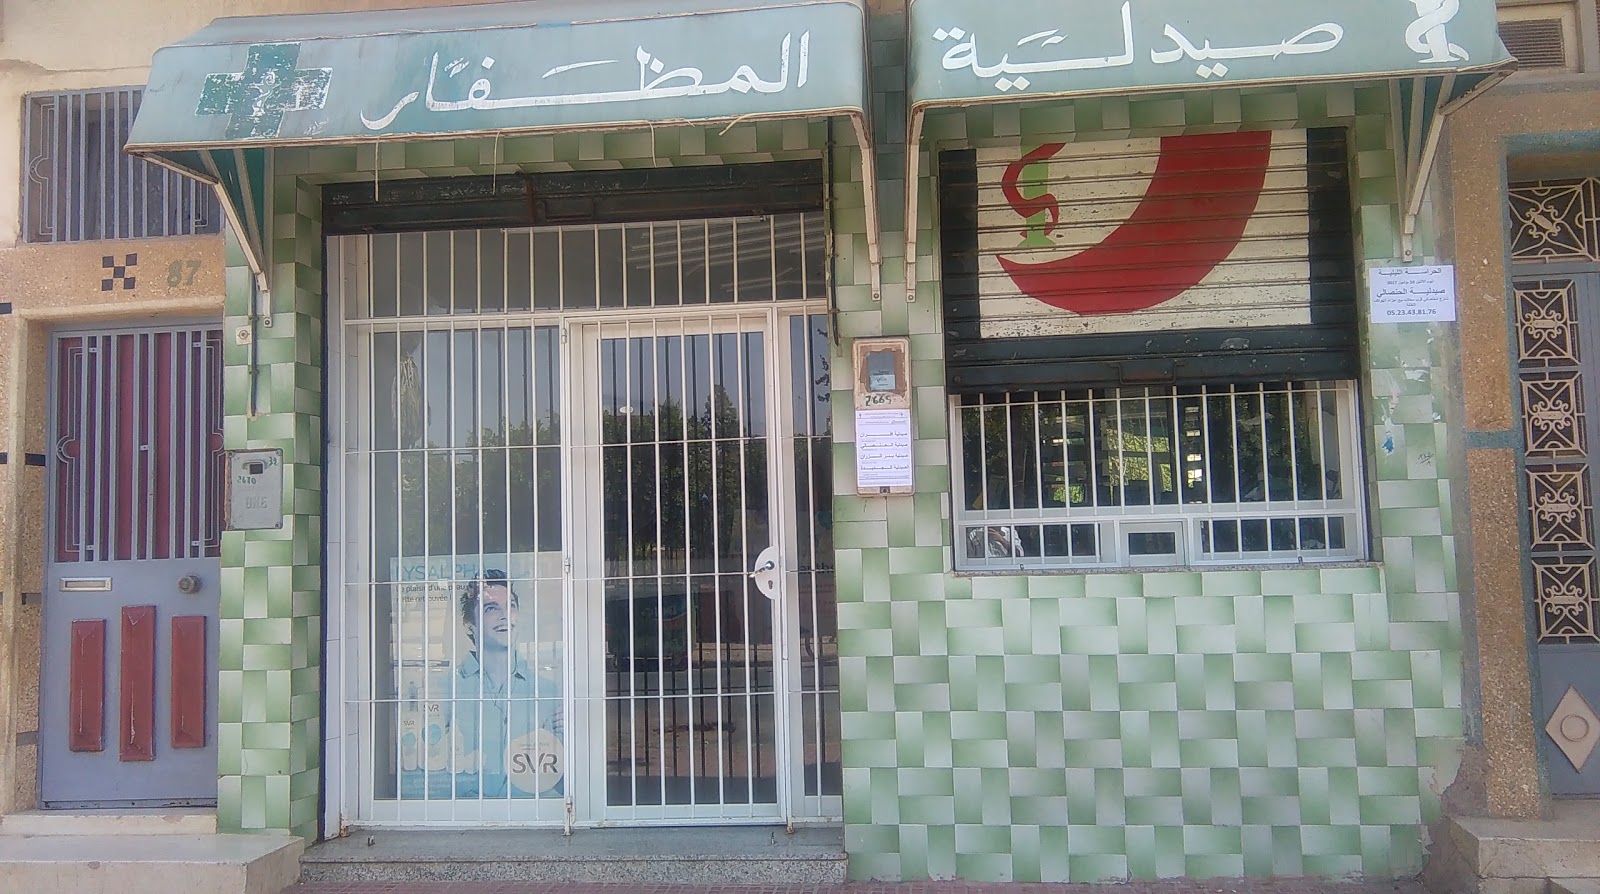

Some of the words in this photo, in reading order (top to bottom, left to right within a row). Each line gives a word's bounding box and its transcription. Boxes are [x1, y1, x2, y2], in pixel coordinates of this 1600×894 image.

[932, 1, 1345, 92] صيدلية
[167, 259, 200, 288] 87
[1410, 287, 1446, 296] صيدلية
[415, 594, 448, 603] retouvée
[512, 752, 559, 774] SVR
